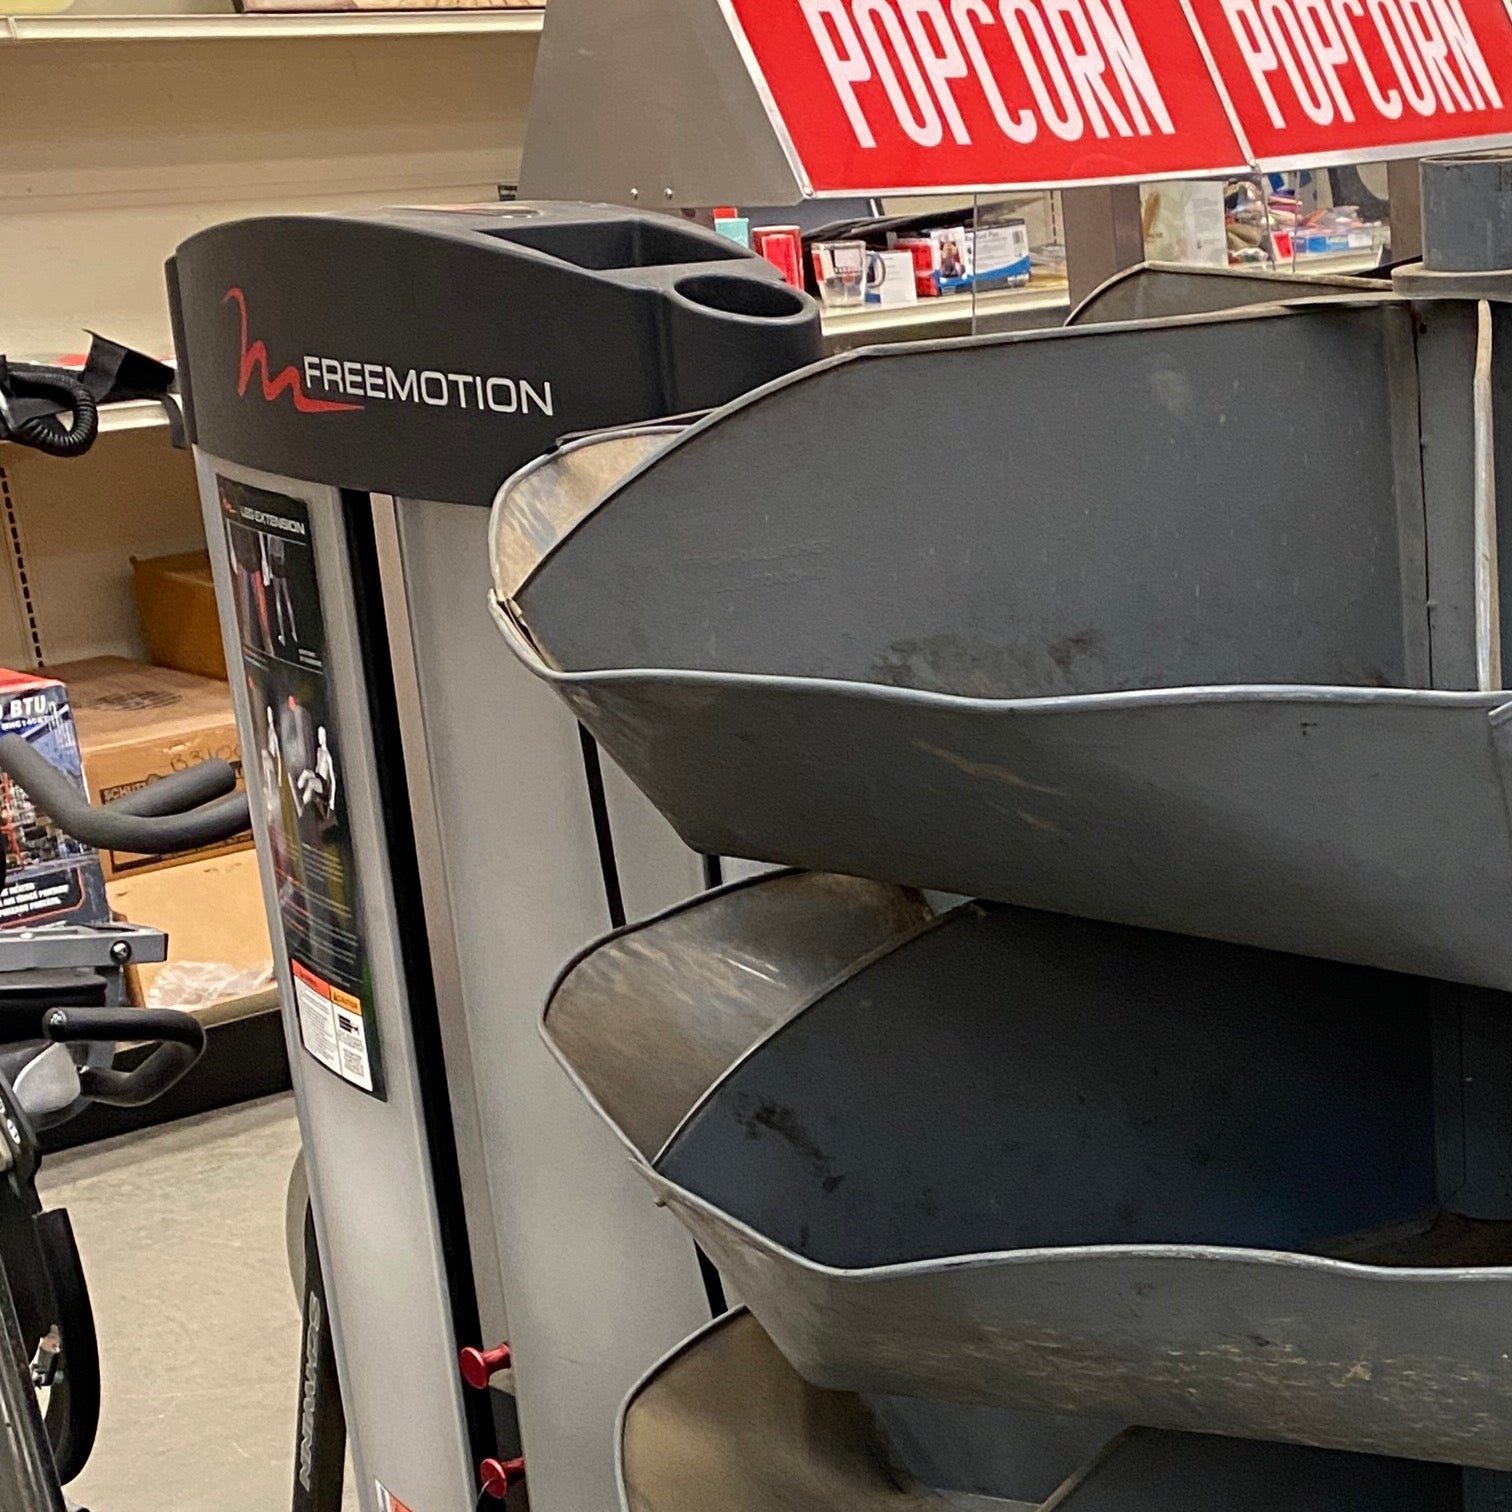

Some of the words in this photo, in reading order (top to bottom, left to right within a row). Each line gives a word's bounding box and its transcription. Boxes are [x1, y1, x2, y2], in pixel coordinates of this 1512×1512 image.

[799, 0, 1176, 149] POPCORN
[1219, 0, 1503, 130] POPCORN
[303, 355, 554, 417] FREEMOTION
[10, 694, 46, 719] BTU
[299, 1290, 321, 1493] SCHWINN
